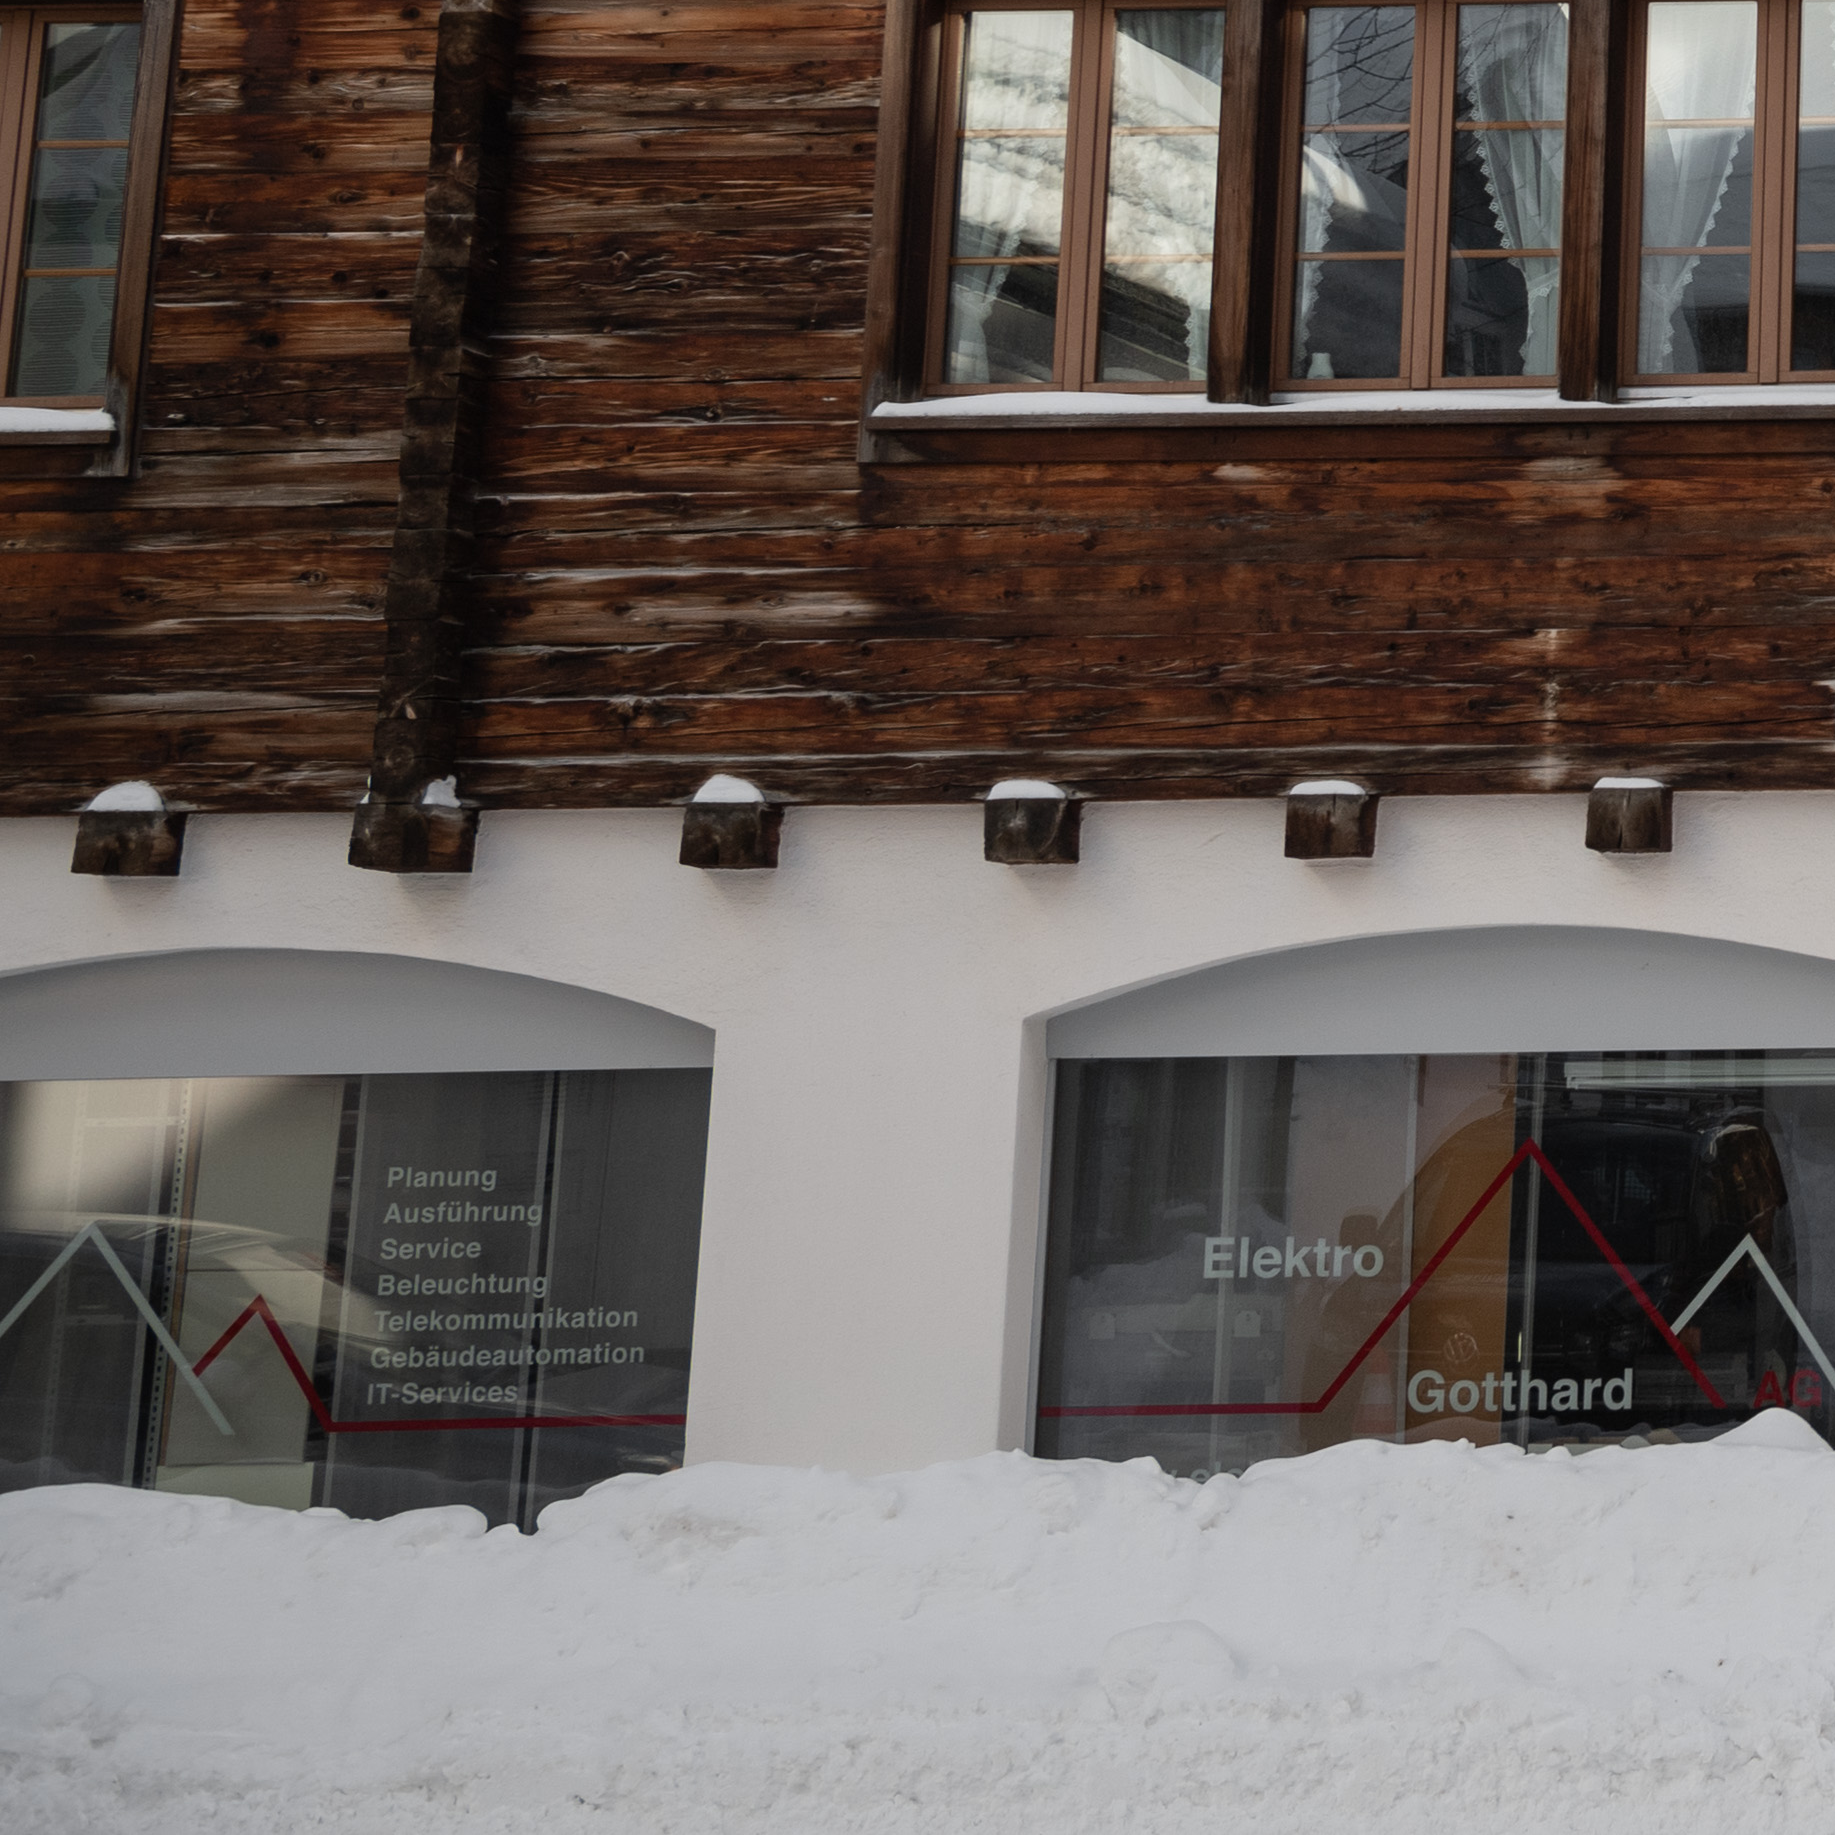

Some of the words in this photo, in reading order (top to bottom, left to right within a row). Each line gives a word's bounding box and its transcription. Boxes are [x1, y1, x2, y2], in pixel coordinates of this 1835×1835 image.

[387, 1167, 497, 1192] Planung
[383, 1201, 543, 1226] Ausführung
[380, 1237, 482, 1260] Service
[1203, 1236, 1384, 1278] Elektro
[377, 1273, 548, 1298] Beleuchtung
[374, 1306, 639, 1332] Telekommunikation
[370, 1342, 645, 1368] Gebäudeautomation
[366, 1381, 519, 1405] IT-Services
[1407, 1368, 1634, 1413] Gotthard
[1753, 1369, 1823, 1408] AG
